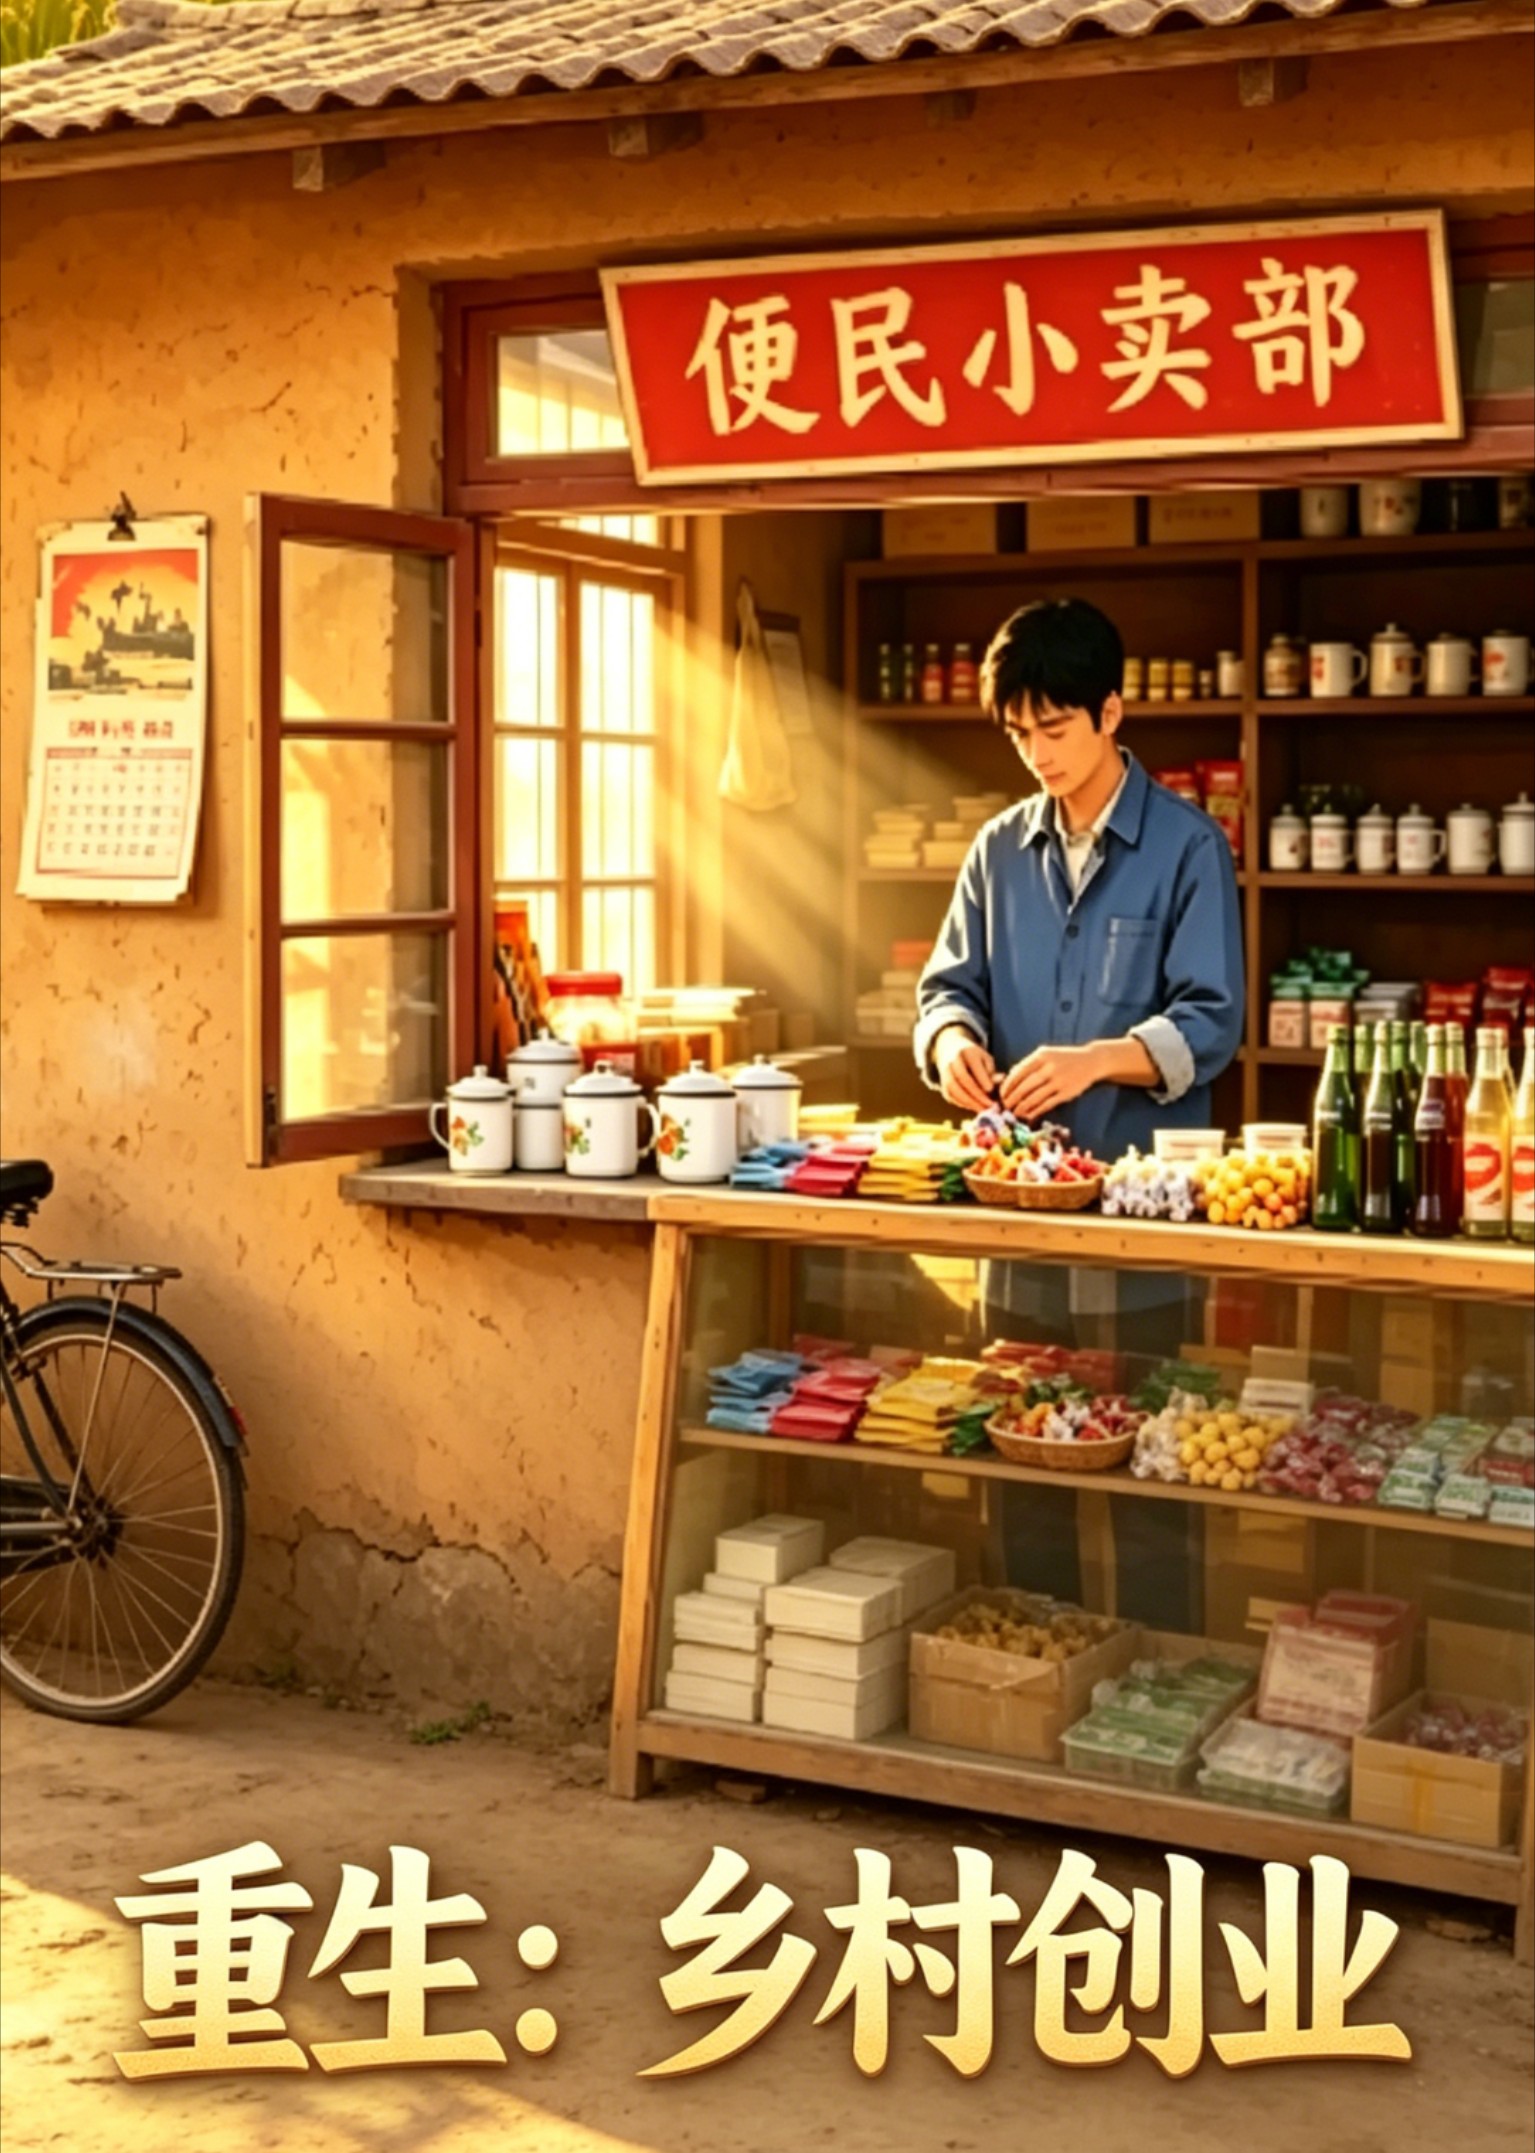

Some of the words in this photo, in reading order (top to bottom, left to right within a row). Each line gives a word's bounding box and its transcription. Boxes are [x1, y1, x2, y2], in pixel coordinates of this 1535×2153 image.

[685, 257, 1364, 437] 便民小卖部
